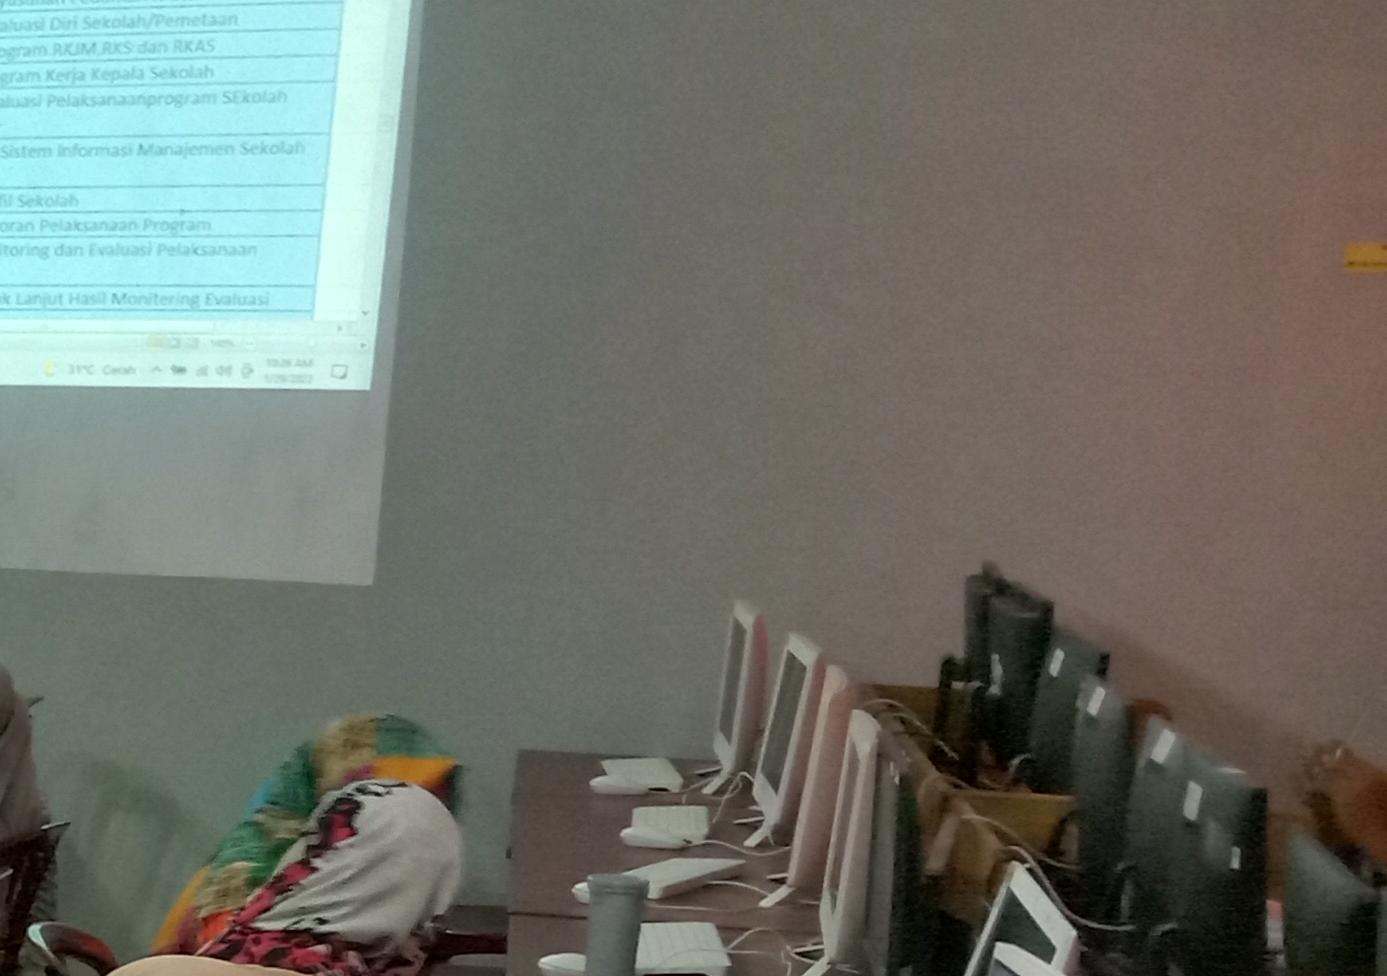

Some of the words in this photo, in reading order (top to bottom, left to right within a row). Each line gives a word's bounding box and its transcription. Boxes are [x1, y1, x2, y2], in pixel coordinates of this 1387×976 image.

[50, 16, 77, 31] Diri
[82, 12, 240, 30] Sekolah/Pemetaan
[137, 39, 168, 54] dan
[173, 38, 216, 53] RKAS
[46, 67, 85, 85] Kerja
[91, 66, 145, 83] Kepala
[151, 65, 215, 80] Sekolah
[0, 144, 53, 159] Sistem
[57, 142, 133, 158] Informasi
[137, 142, 235, 160] Manajemen
[239, 140, 306, 156] Sekolah
[17, 194, 80, 208] Sekolah
[39, 218, 138, 233] Pelaksanaan
[142, 218, 213, 235] Program
[54, 242, 84, 257] dan
[88, 241, 153, 257] Evaluasi
[157, 242, 258, 257] Pelaksanaan
[15, 291, 64, 309] Lanjut
[68, 291, 108, 306] Hasil
[204, 291, 270, 306] Evaluasi
